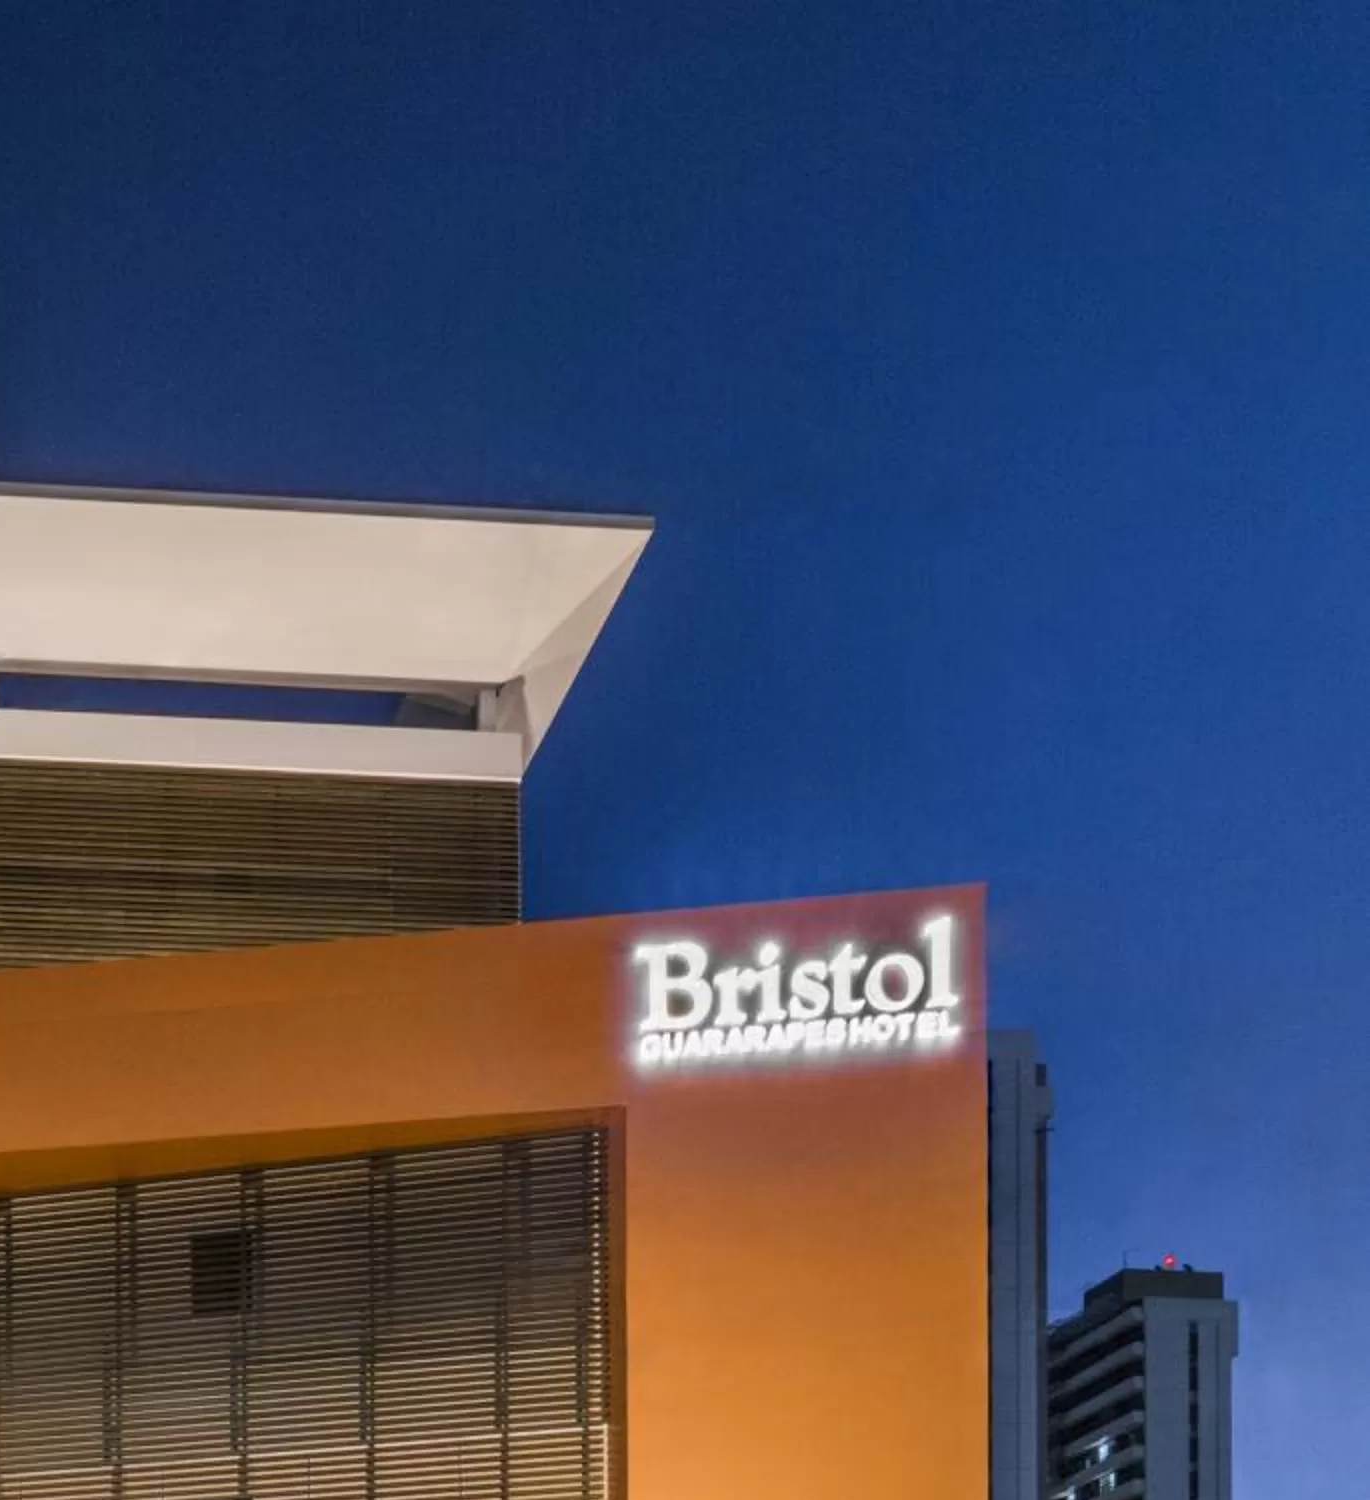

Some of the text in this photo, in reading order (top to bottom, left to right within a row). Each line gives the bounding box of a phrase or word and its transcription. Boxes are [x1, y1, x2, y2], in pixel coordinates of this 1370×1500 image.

[633, 915, 959, 1031] Bristol
[639, 1010, 960, 1060] GUARARAPES HOTEL
